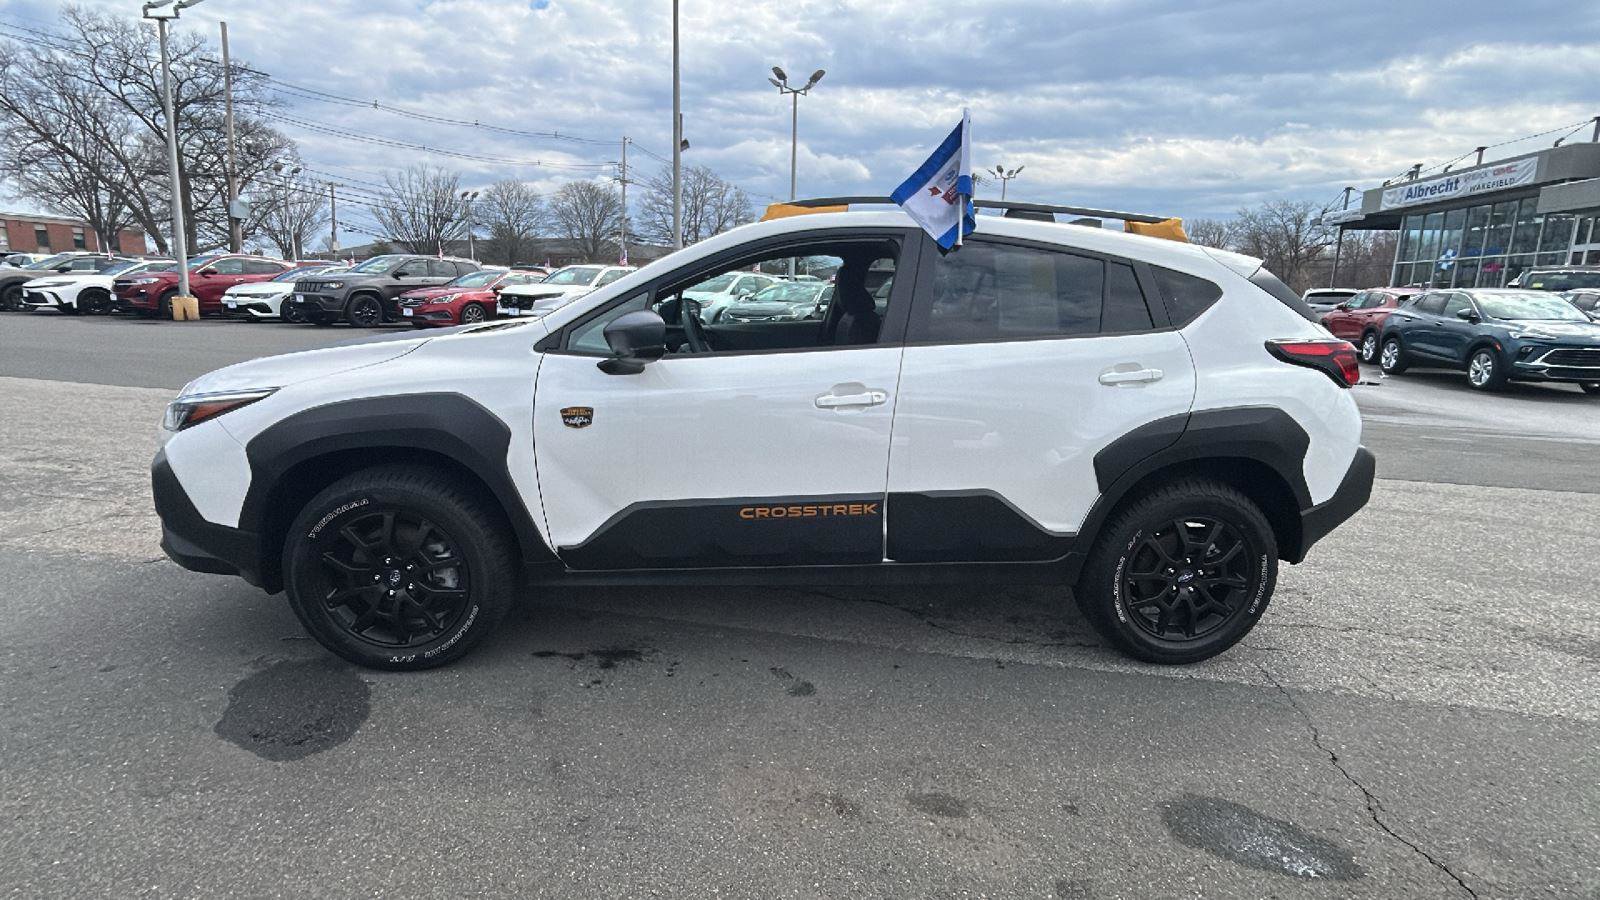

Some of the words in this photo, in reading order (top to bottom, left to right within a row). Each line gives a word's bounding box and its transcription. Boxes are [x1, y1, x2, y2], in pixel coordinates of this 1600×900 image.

[1405, 178, 1460, 200] Albrecht
[1470, 177, 1515, 192] WAKEFIELD
[739, 503, 878, 519] CROSSTREK
